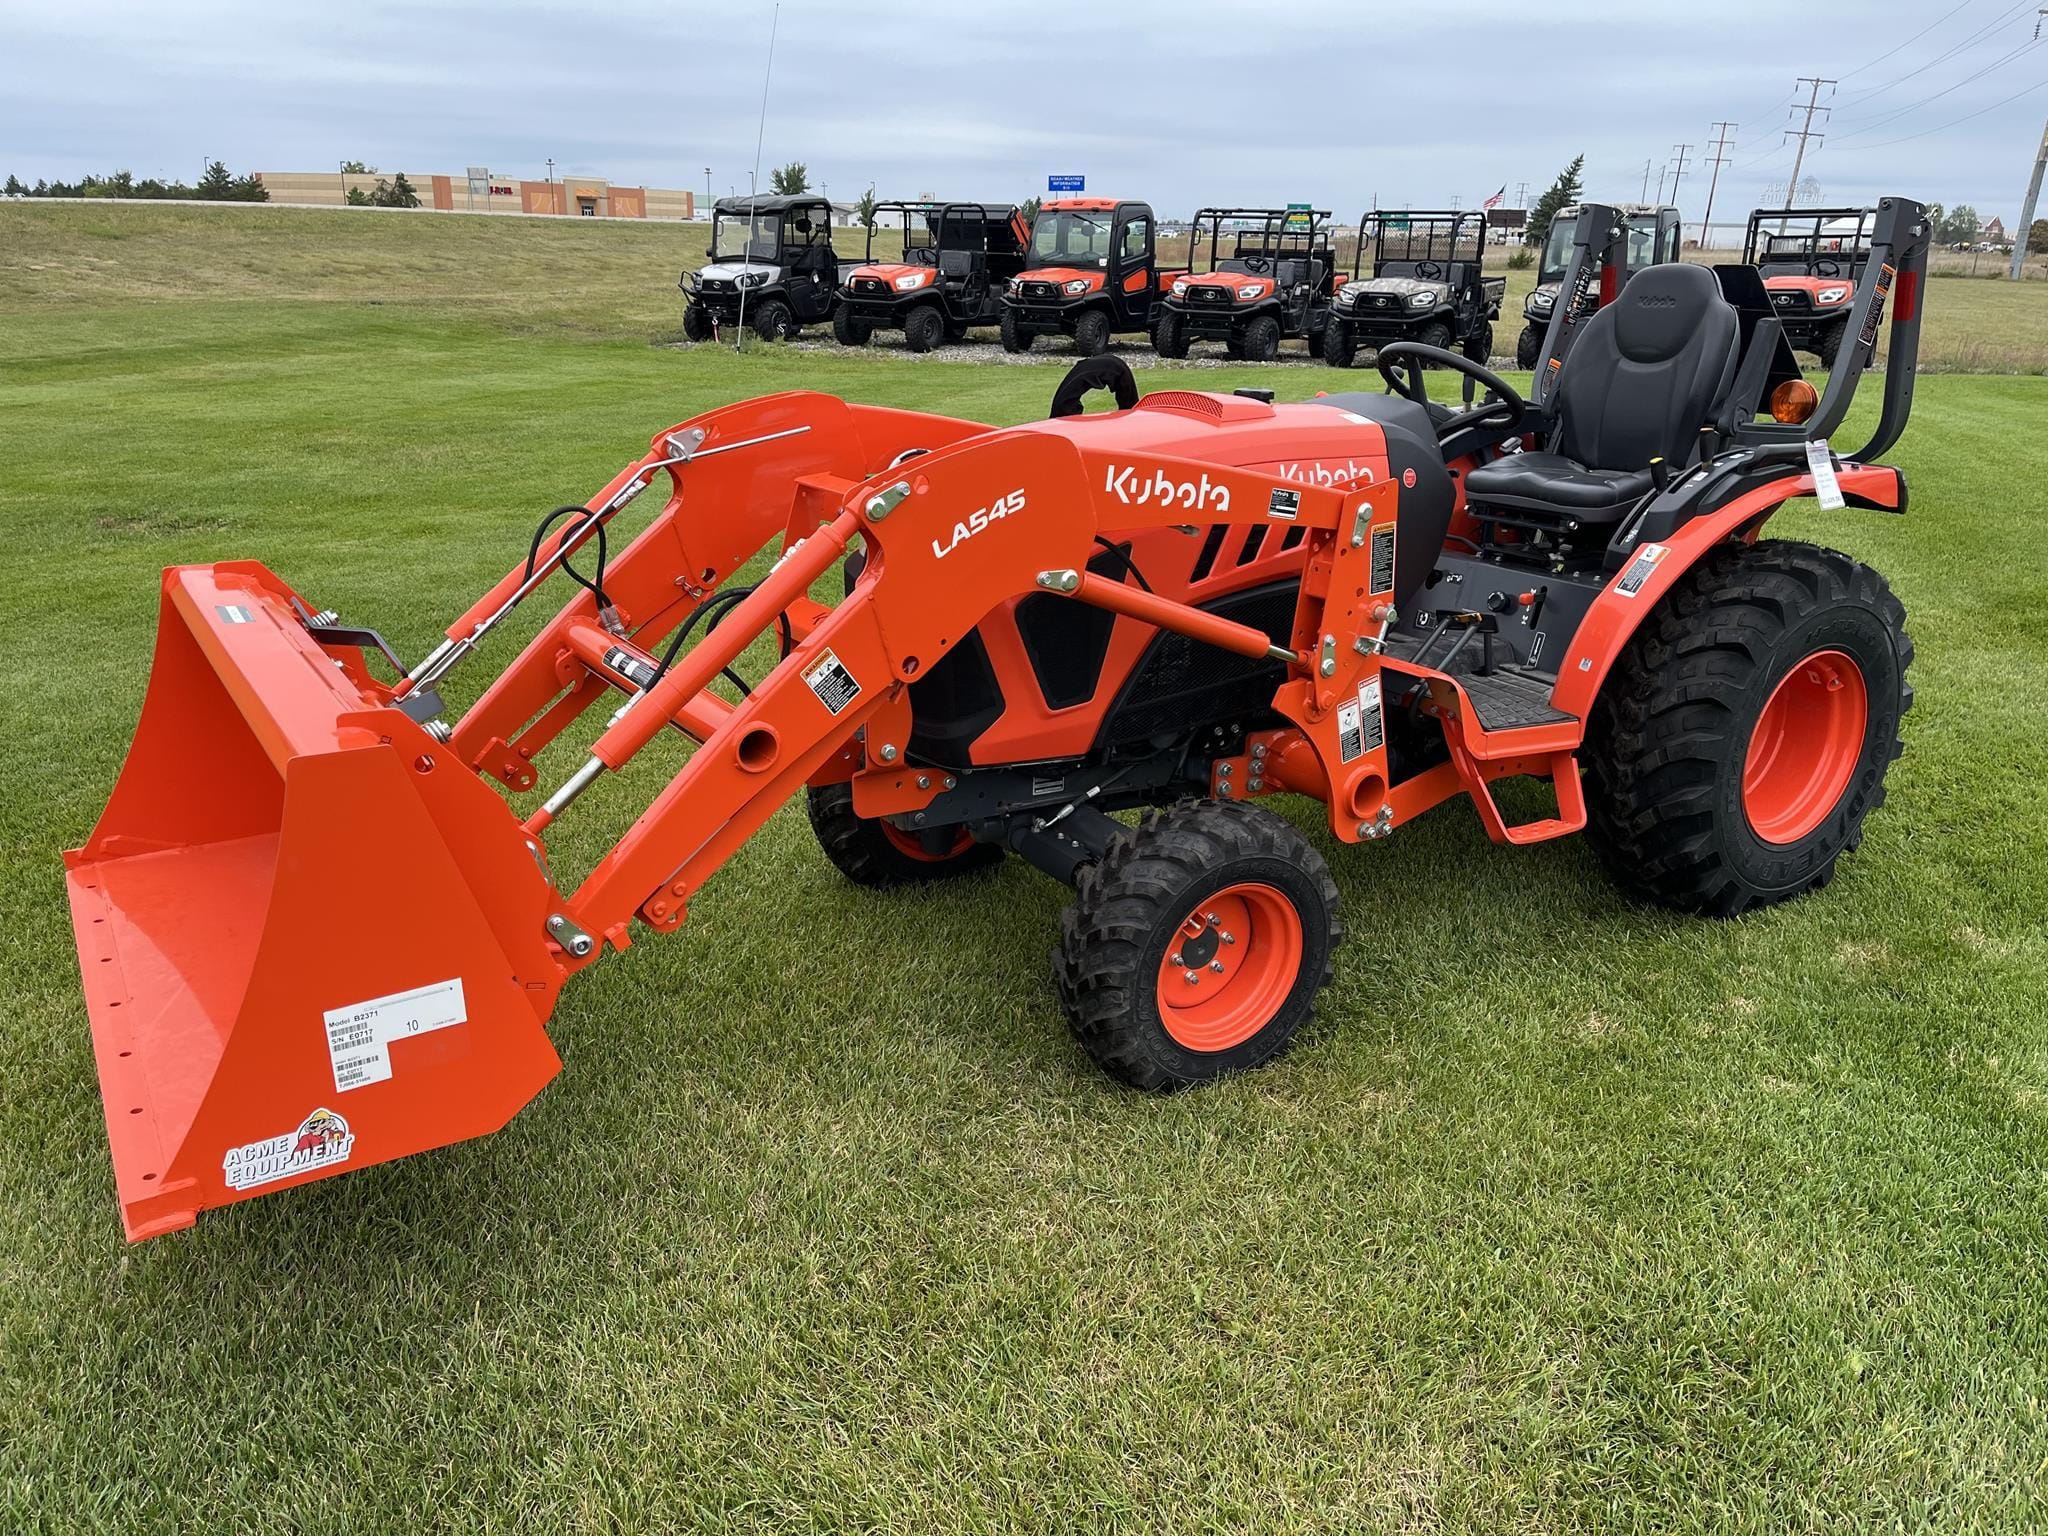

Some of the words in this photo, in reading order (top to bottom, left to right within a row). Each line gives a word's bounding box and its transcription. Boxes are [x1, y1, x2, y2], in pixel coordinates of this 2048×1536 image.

[1105, 464, 1231, 512] Kubota
[1280, 459, 1374, 488] Kubota
[931, 487, 1026, 560] LA545
[328, 1018, 351, 1029] Model
[353, 1010, 379, 1022] B2371
[406, 1019, 419, 1032] 10
[331, 1035, 345, 1045] S/N
[349, 1029, 373, 1041] E0717
[226, 1137, 289, 1168] ACME
[227, 1136, 352, 1184] EQUIPMENT
